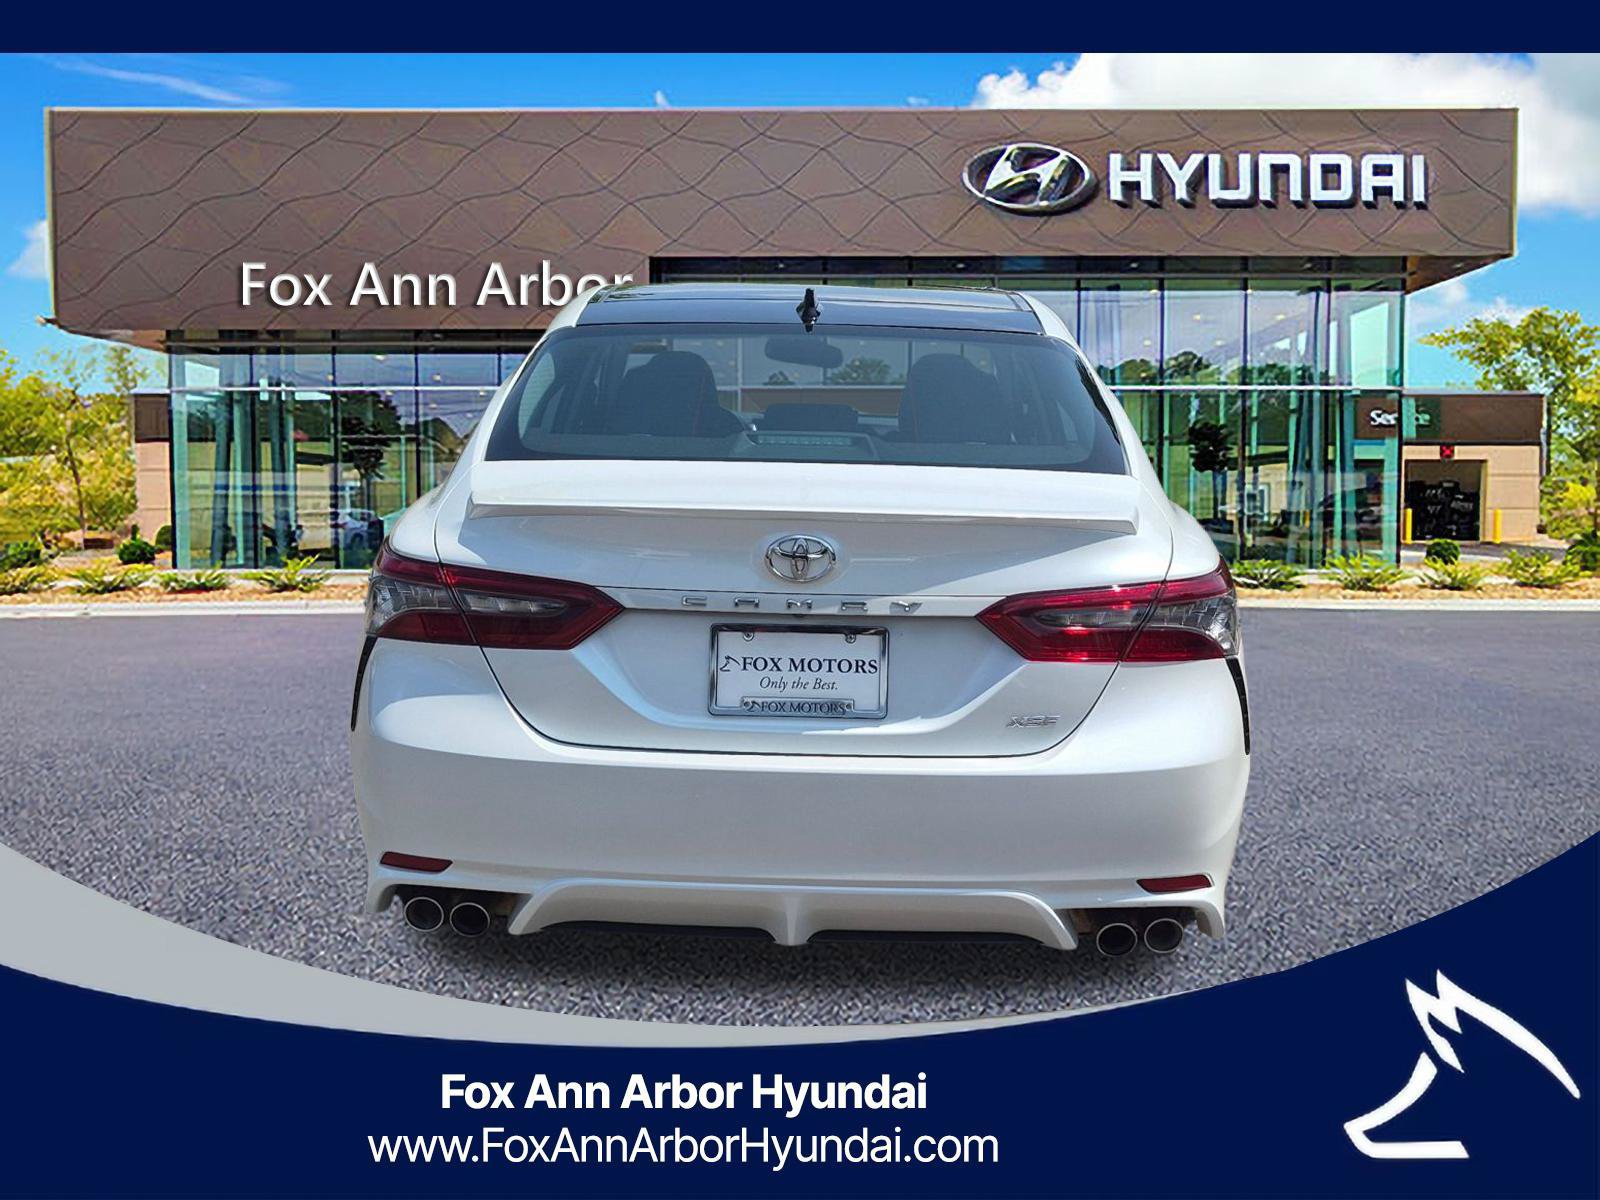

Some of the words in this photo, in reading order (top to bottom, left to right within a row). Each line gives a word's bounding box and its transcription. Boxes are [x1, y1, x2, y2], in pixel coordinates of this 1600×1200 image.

[1108, 152, 1426, 204] HYUNDAI
[241, 261, 334, 306] Fox
[349, 261, 457, 306] Ann
[682, 596, 922, 612] CAMRY
[741, 656, 783, 672] FOX
[788, 657, 878, 675] MOTORS
[759, 675, 788, 693] Only
[791, 677, 808, 690] the
[812, 678, 839, 690] Best.
[760, 702, 787, 713] FOX
[790, 703, 847, 716] MOTORS
